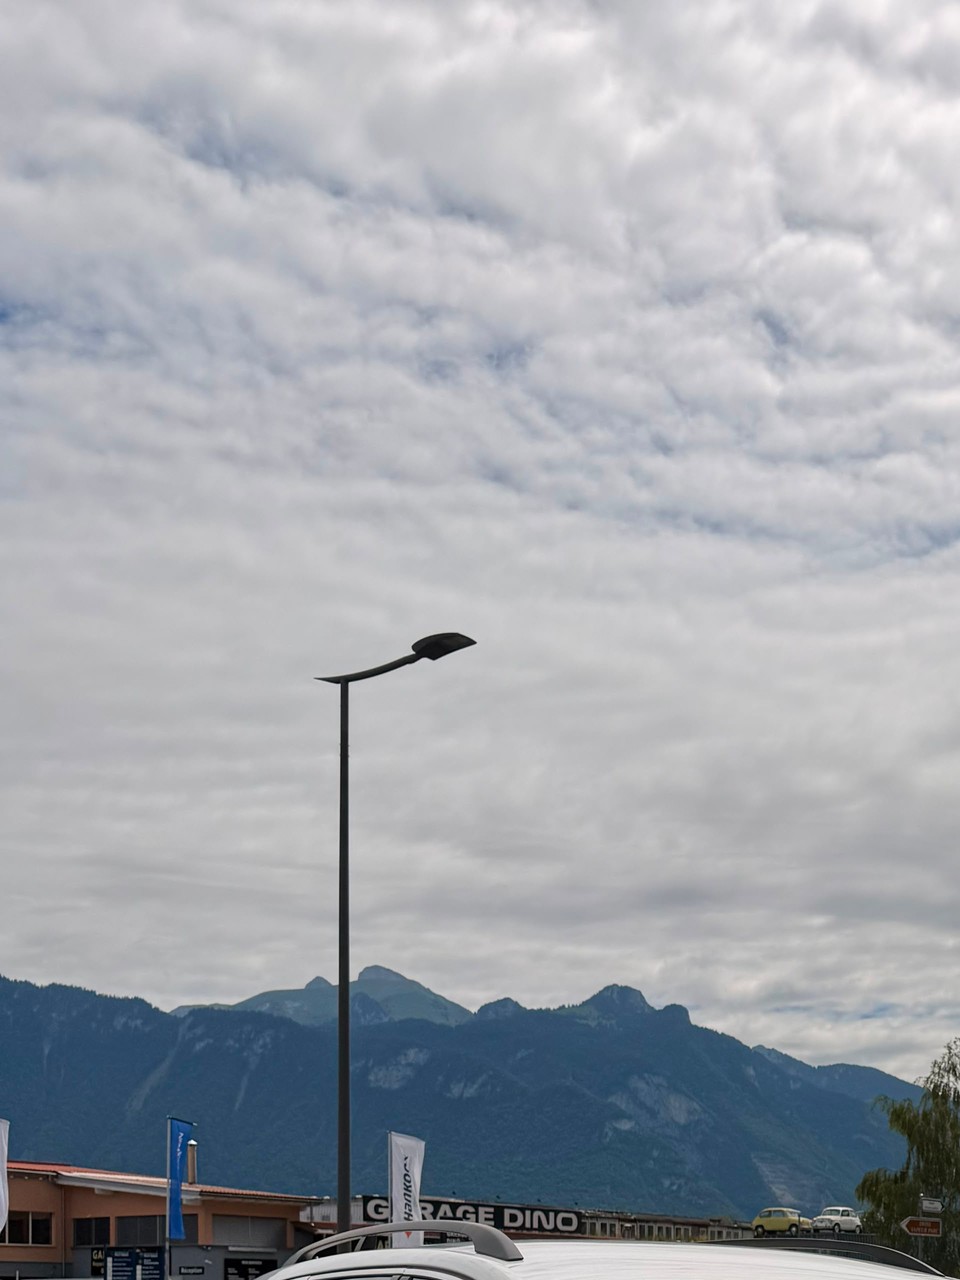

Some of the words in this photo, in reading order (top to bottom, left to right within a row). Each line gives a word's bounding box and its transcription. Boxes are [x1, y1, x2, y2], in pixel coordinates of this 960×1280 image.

[403, 1156, 414, 1222] Hanko
[366, 1199, 495, 1227] GRAGE
[503, 1208, 579, 1232] DINO
